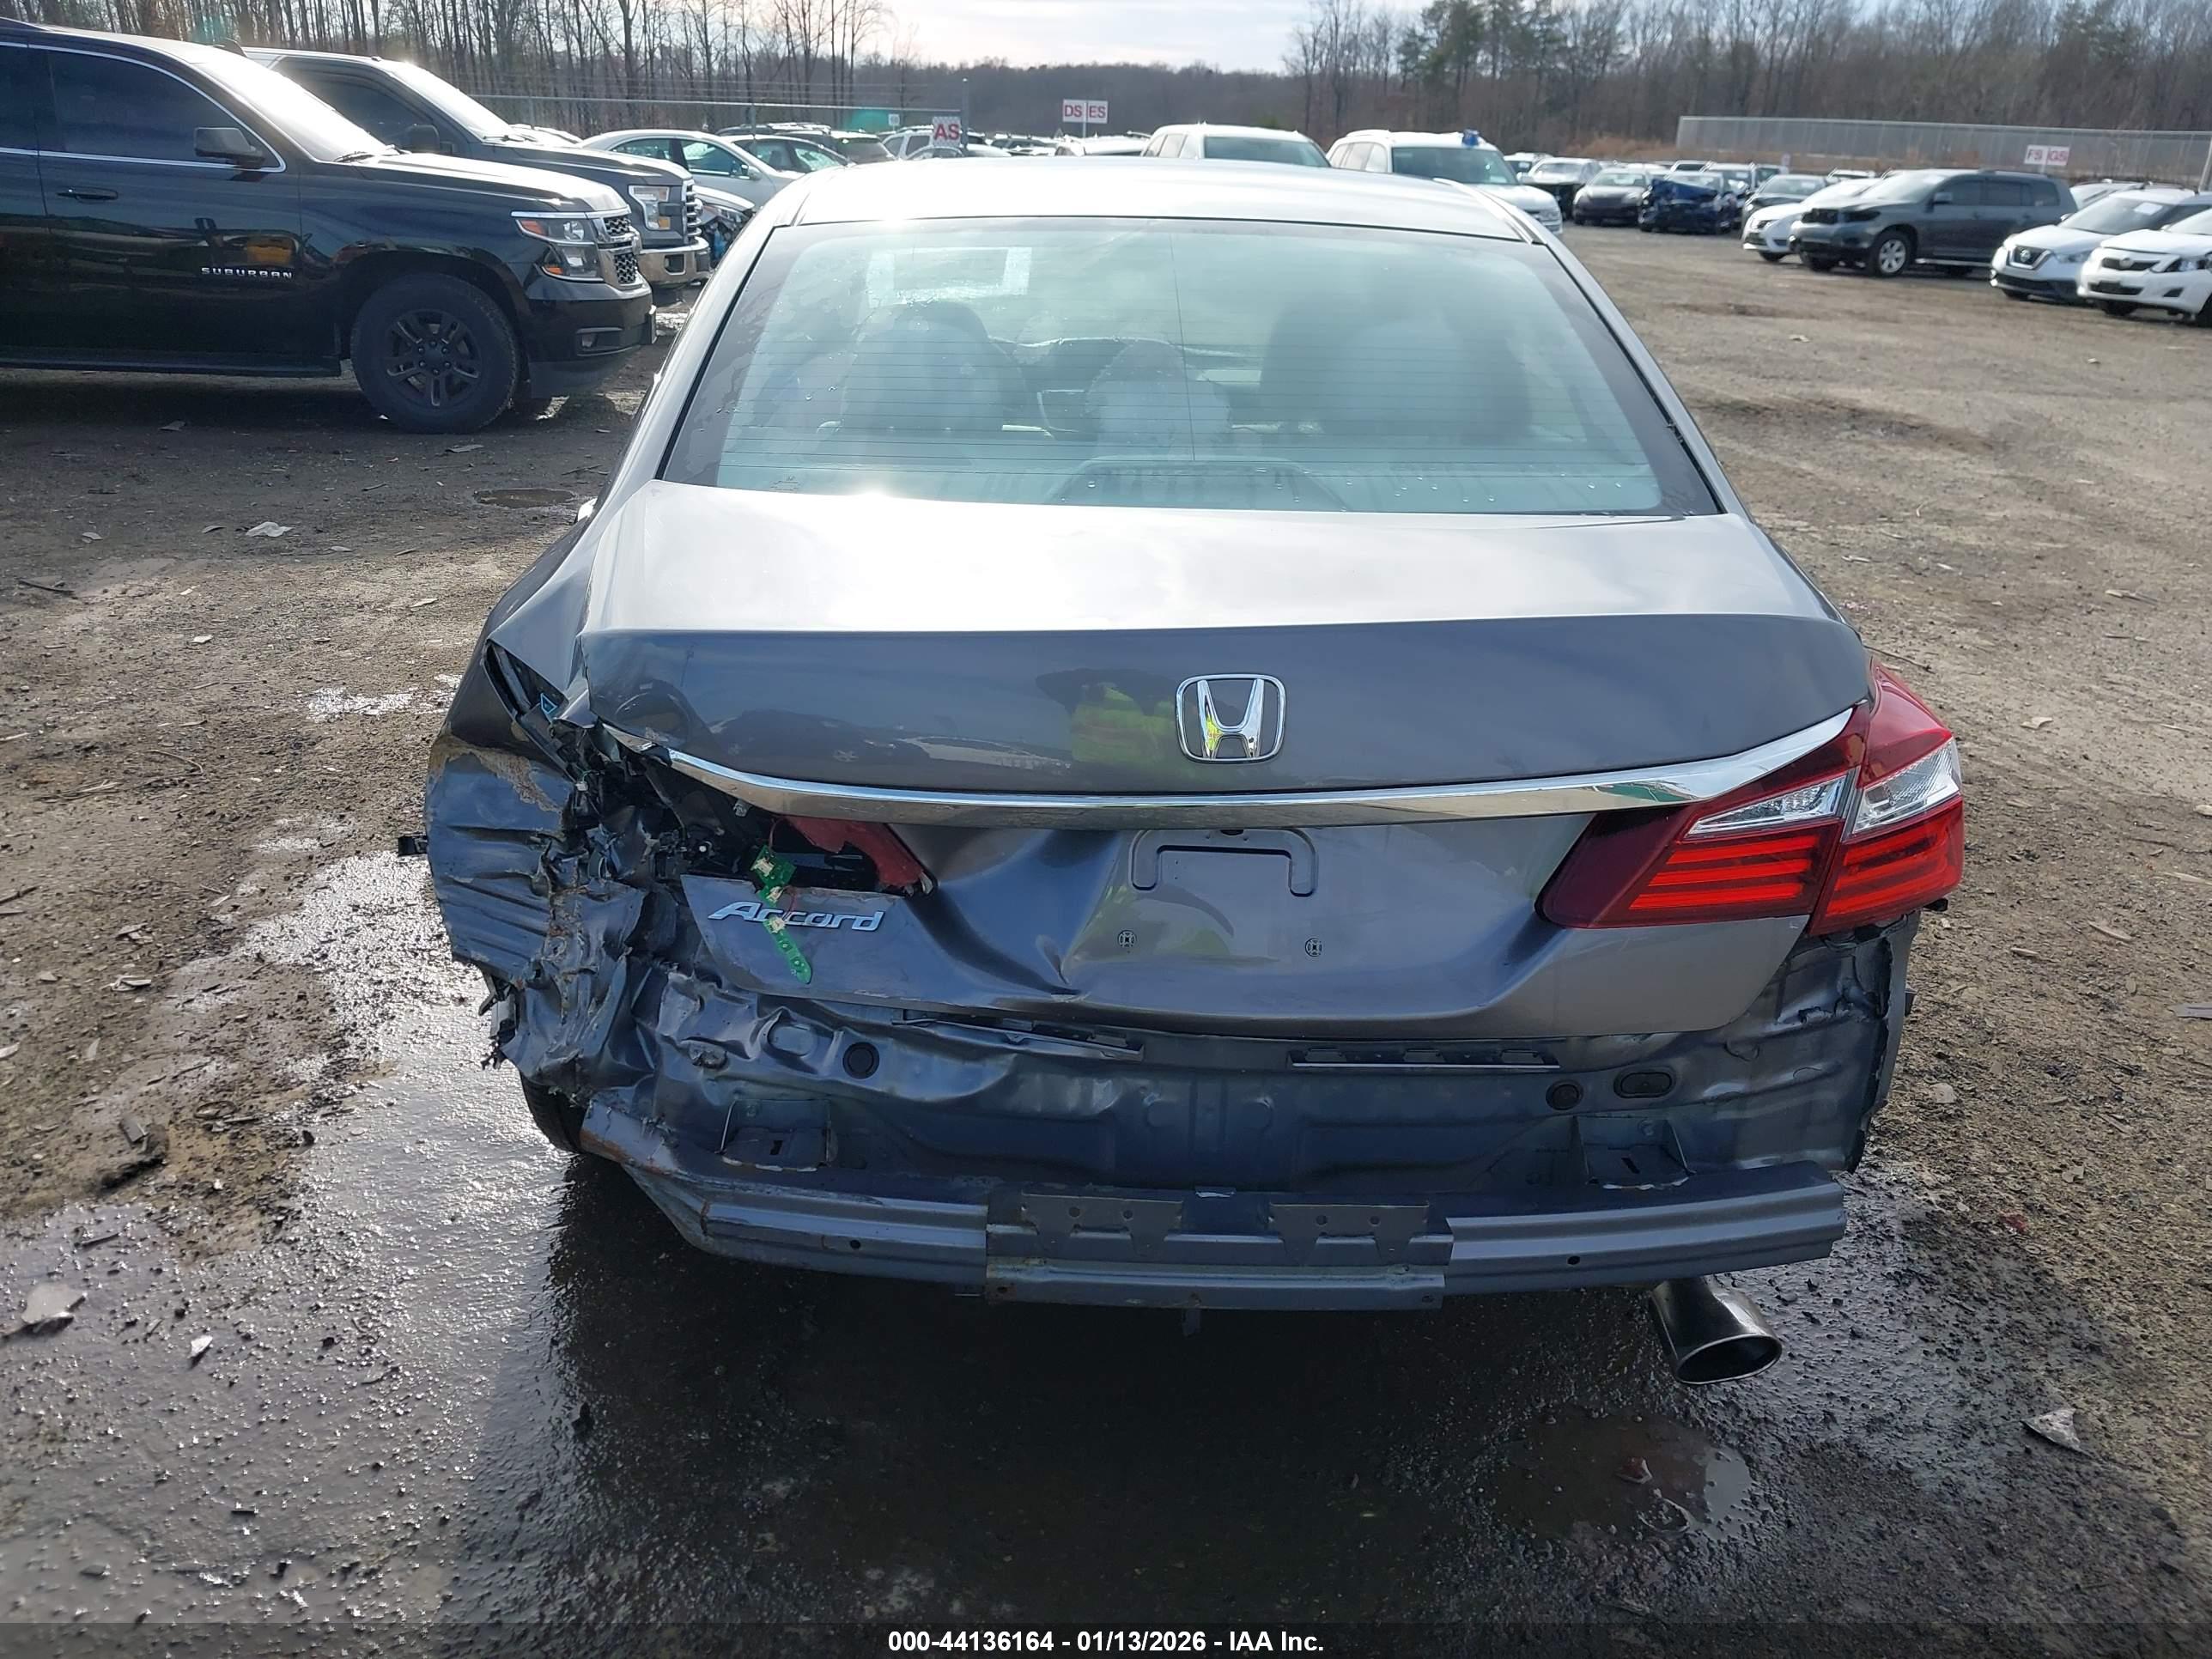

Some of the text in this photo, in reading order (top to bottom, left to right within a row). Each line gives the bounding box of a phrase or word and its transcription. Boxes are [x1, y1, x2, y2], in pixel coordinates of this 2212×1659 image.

[1065, 105, 1082, 118] DS
[1089, 106, 1107, 118] ES
[934, 124, 959, 140] AS
[201, 267, 293, 278] SUBURBAN
[708, 901, 884, 932] Accord
